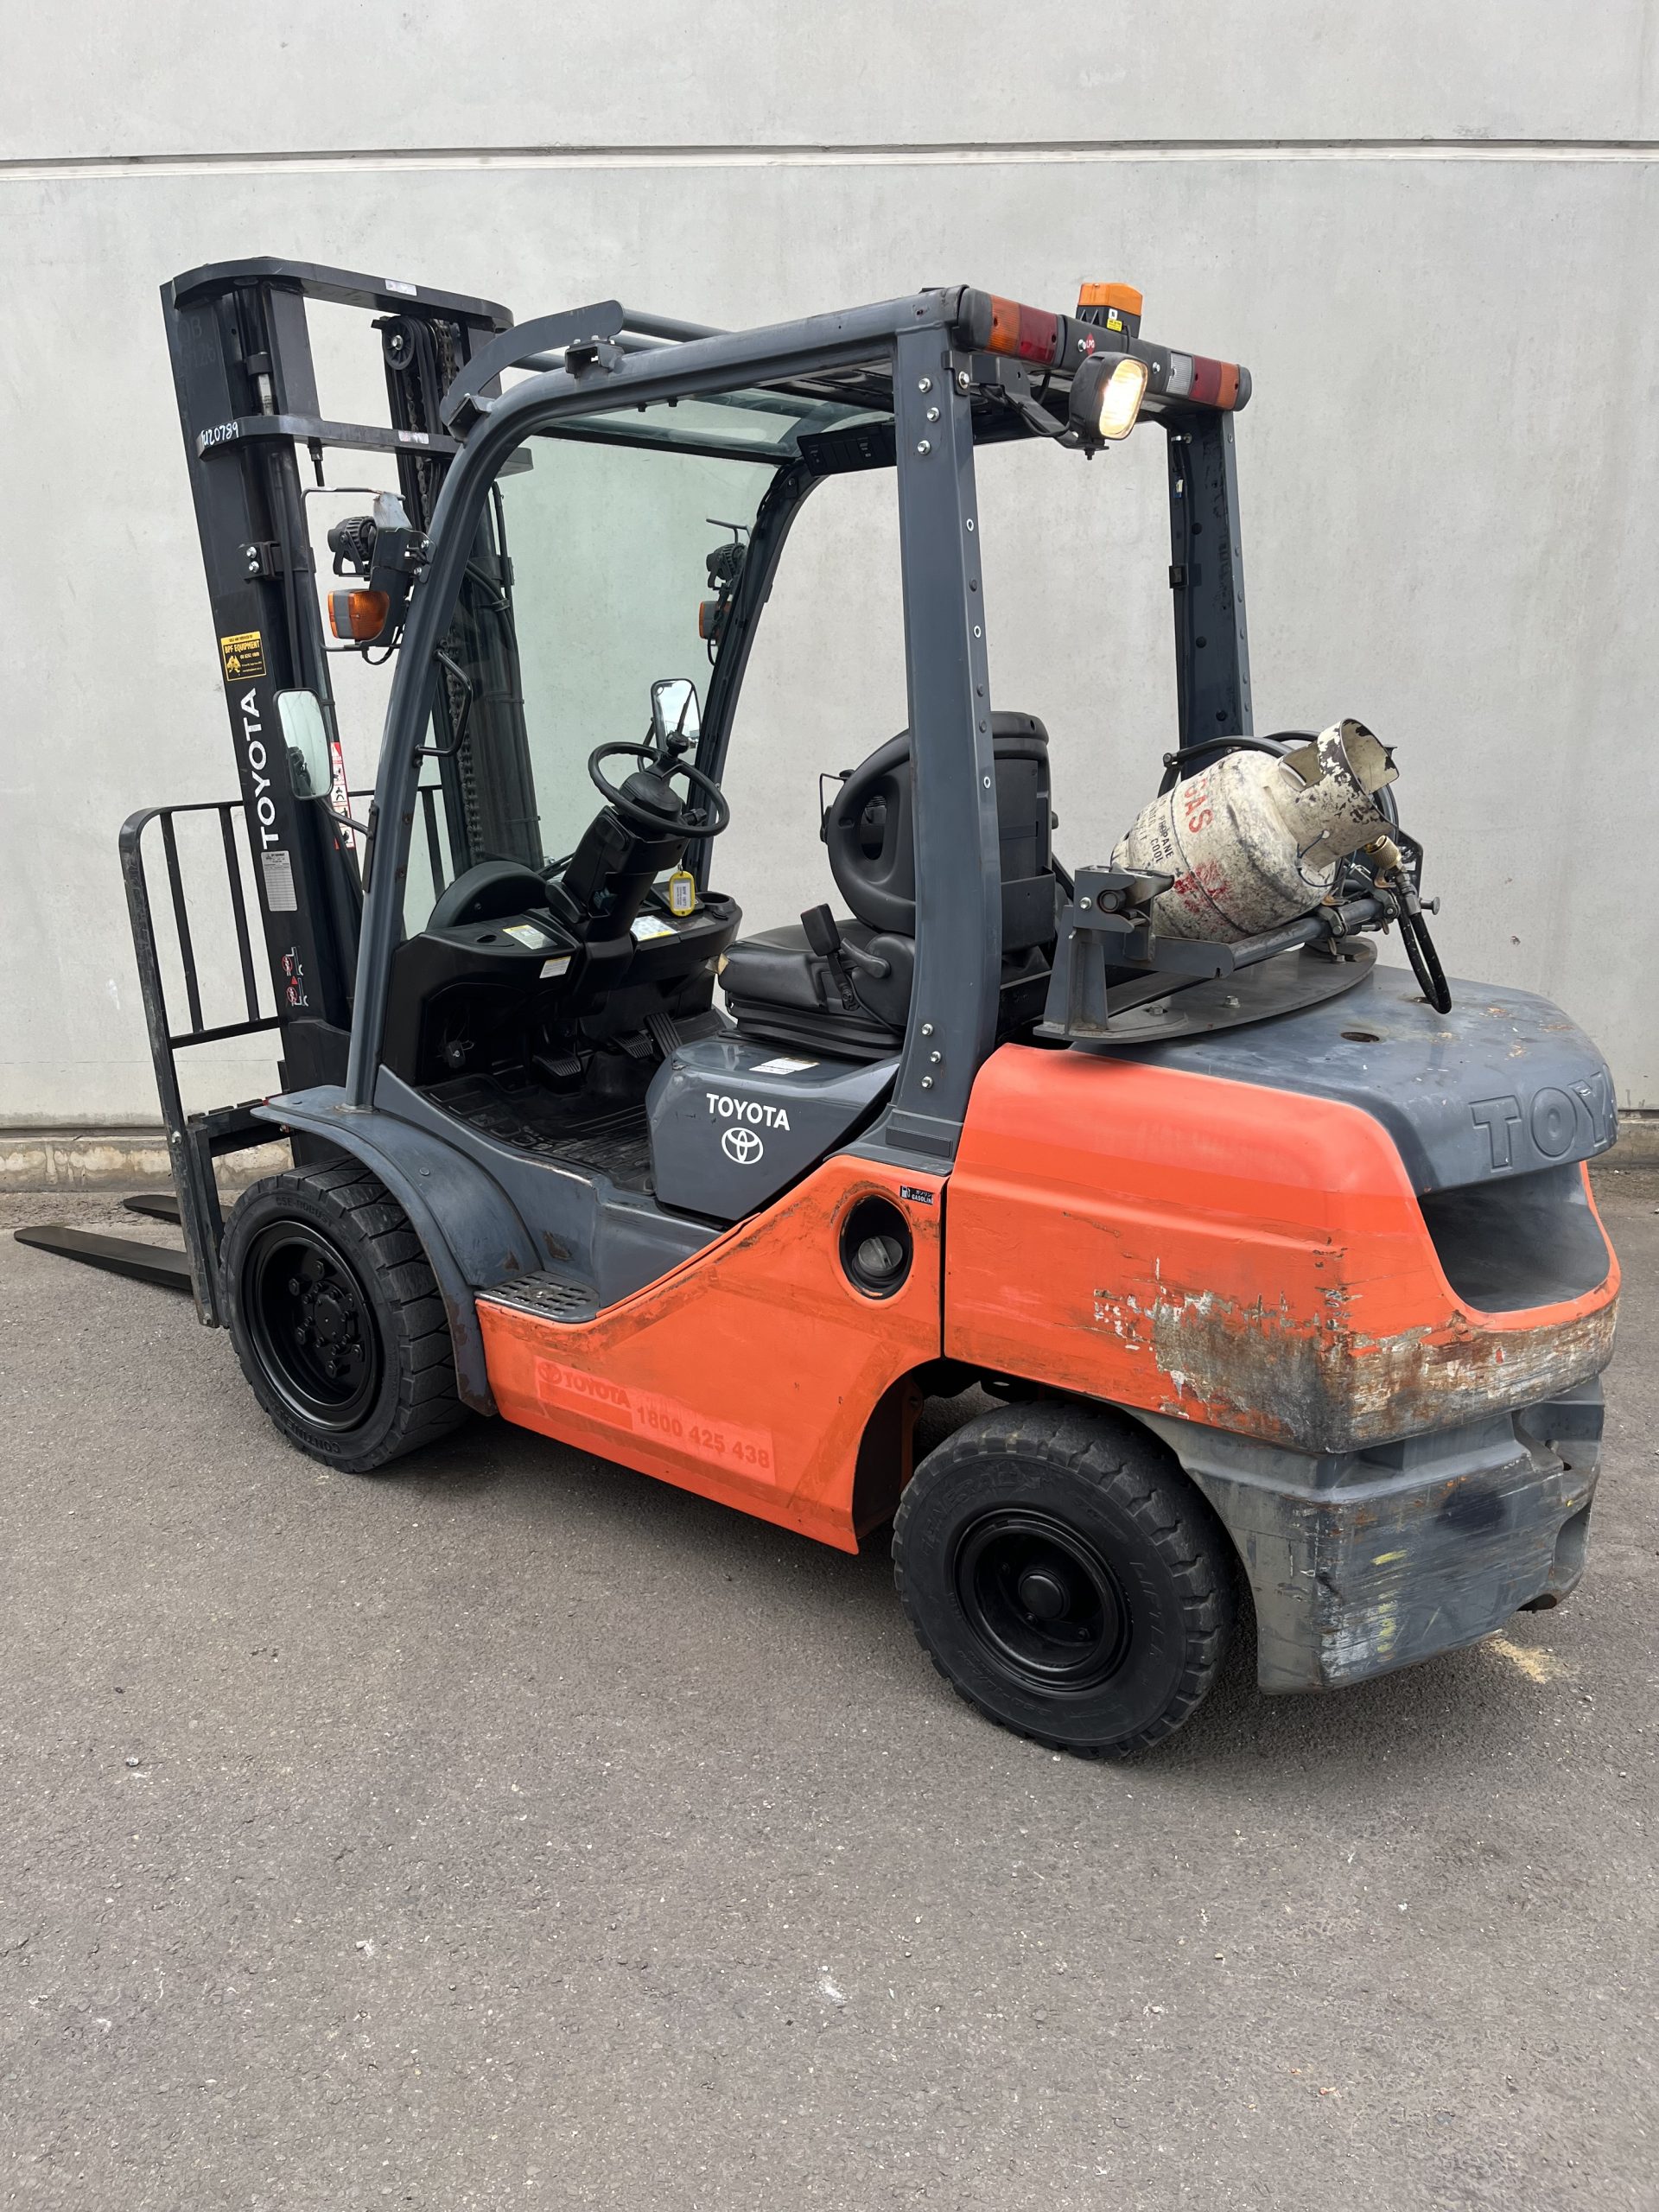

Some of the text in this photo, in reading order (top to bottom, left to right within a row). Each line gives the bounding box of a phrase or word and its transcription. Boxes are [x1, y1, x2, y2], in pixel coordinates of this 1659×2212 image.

[1086, 340, 1096, 348] LPG
[240, 687, 279, 850] TOYOTA
[1184, 778, 1214, 834] GAS
[706, 1092, 791, 1131] TOYOTA
[1468, 1064, 1617, 1173] TOY
[563, 1370, 632, 1408] TOYOTA
[637, 1406, 770, 1469] 1800 425 438
